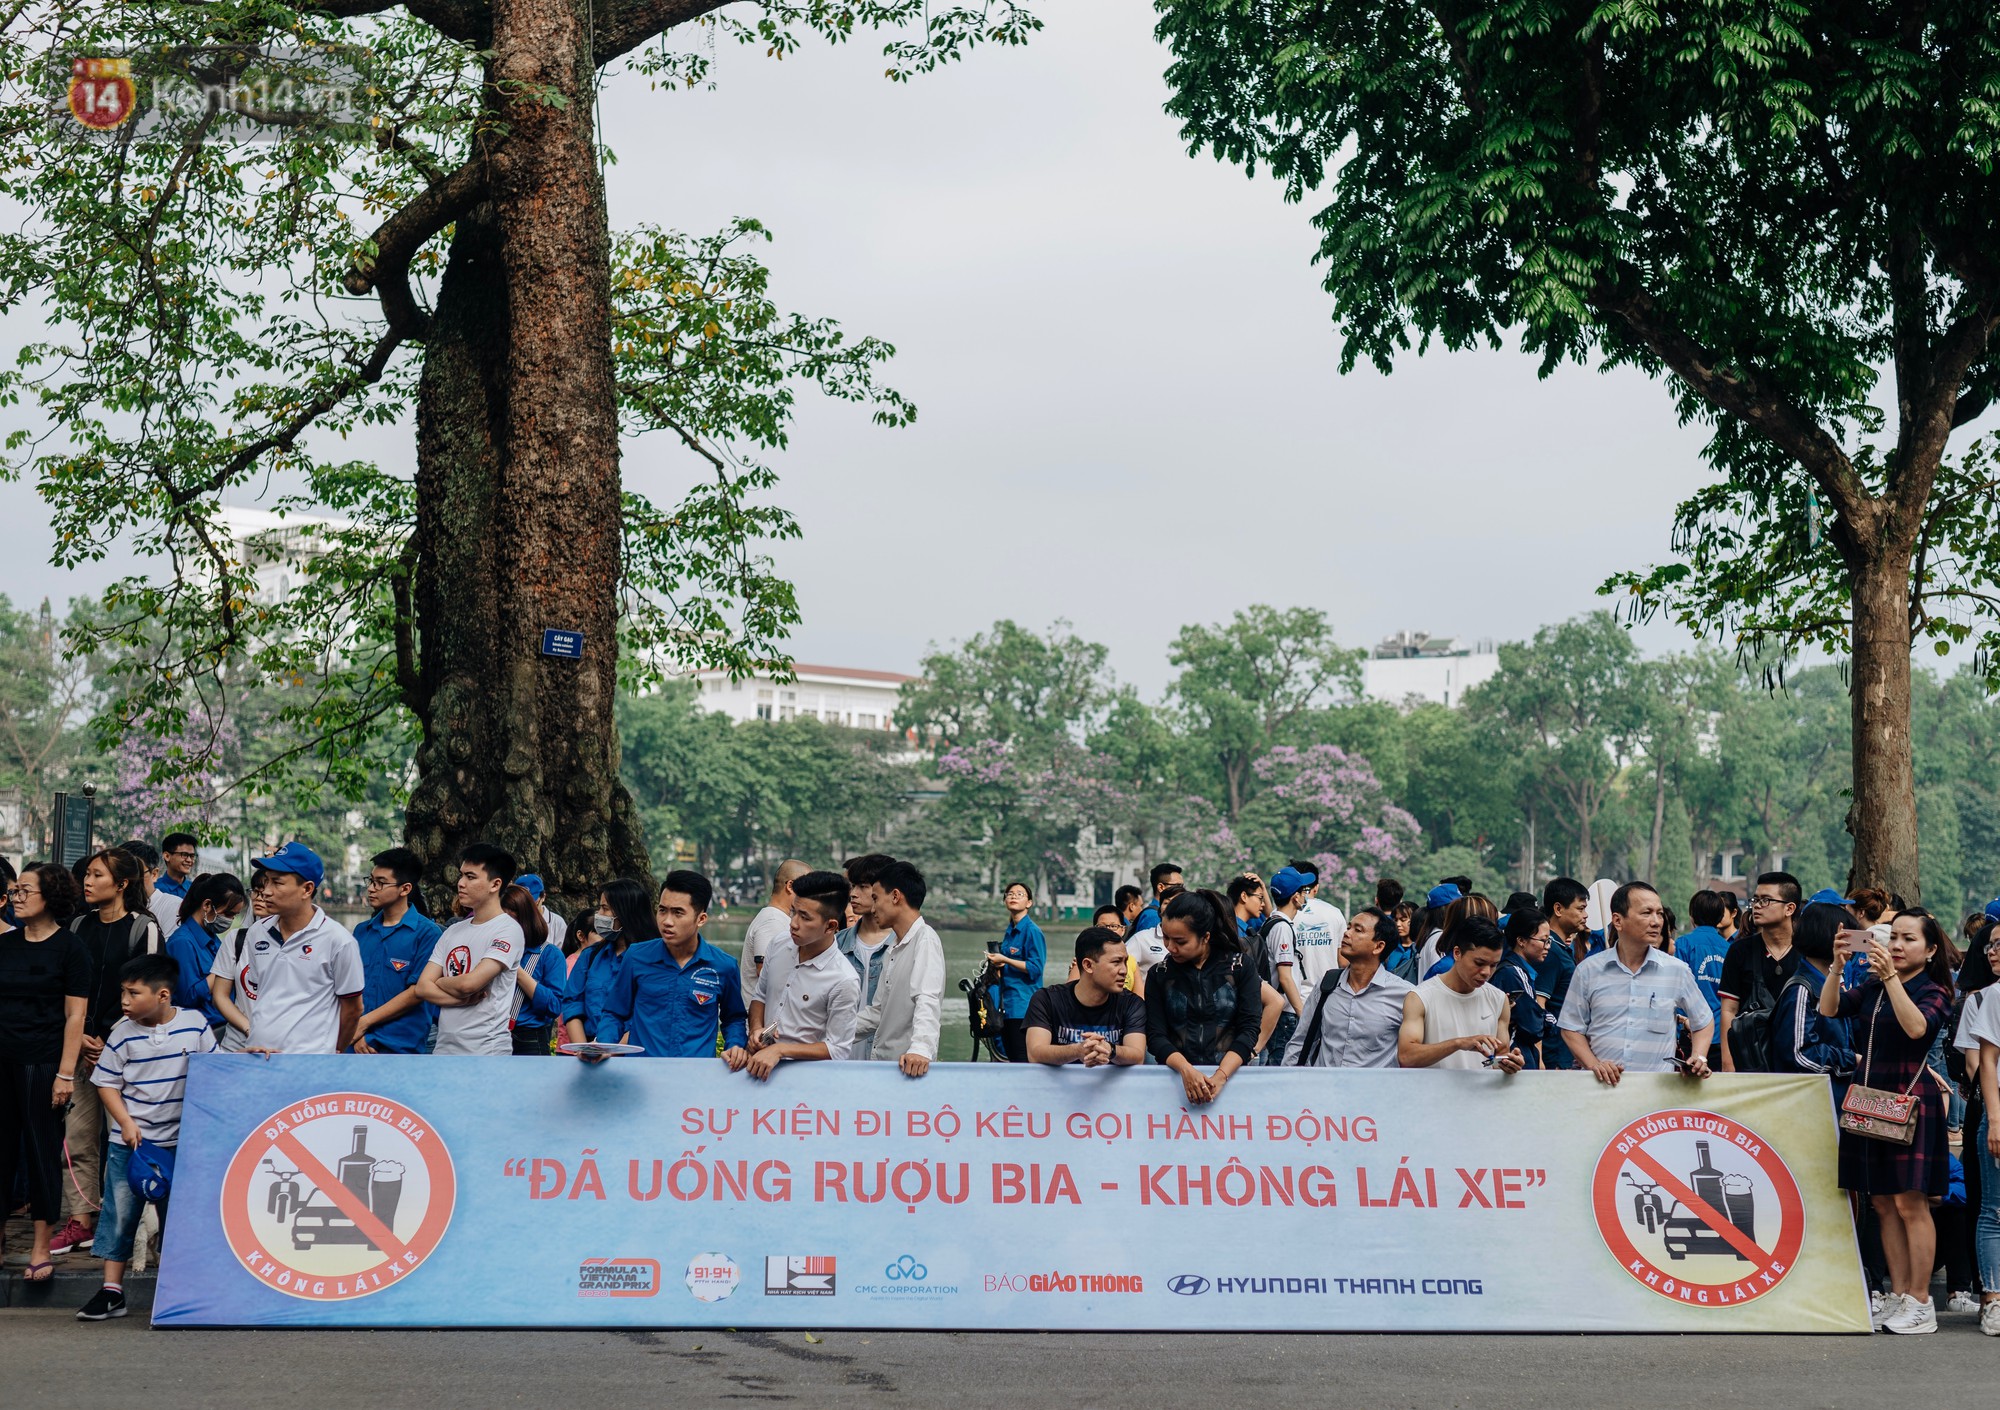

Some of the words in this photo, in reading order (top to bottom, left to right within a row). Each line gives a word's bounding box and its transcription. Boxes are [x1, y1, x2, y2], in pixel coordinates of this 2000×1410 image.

[265, 1119, 290, 1141] ĐÃ
[291, 1101, 339, 1124] UỐNG
[345, 1100, 394, 1123] RƯỢU,
[397, 1116, 425, 1142] BIA
[1847, 1096, 1906, 1118] GUESS
[681, 1108, 739, 1141] SỰ
[752, 1103, 840, 1141] KIỆN
[854, 1110, 891, 1136] ĐI
[908, 1104, 961, 1143] BỘ
[976, 1105, 1051, 1138] KÊU
[1066, 1112, 1132, 1145] GỌI
[1147, 1106, 1253, 1141] HÀNH
[1266, 1108, 1378, 1147] ĐỘNG
[1616, 1133, 1639, 1155] ĐÃ
[1636, 1116, 1679, 1138] UỐNG
[1683, 1116, 1730, 1138] RƯỢU,
[1734, 1132, 1762, 1157] BIA
[503, 1148, 607, 1200] “ĐÃ
[628, 1145, 792, 1203] UỐNG
[814, 1158, 970, 1214] RƯỢU
[993, 1163, 1082, 1205] BIA
[1140, 1156, 1337, 1208] KHÔNG
[1357, 1156, 1438, 1208] LÁI
[1455, 1168, 1546, 1209] XE”
[246, 1250, 325, 1295] KHÔNG
[337, 1273, 381, 1295] LÁI
[388, 1250, 419, 1277] XE
[579, 1266, 638, 1274] FORMULA
[694, 1267, 732, 1278] 91-94
[1079, 1273, 1143, 1293] THÔNG
[1629, 1259, 1708, 1303] KHÔNG
[1718, 1282, 1758, 1303] LÁI
[1760, 1260, 1786, 1286] XE
[854, 1285, 878, 1294] CMC
[880, 1285, 958, 1294] CORPORATION
[1217, 1277, 1327, 1294] HYUNDAI
[1333, 1278, 1416, 1294] THANH
[1421, 1279, 1484, 1295] CONG
